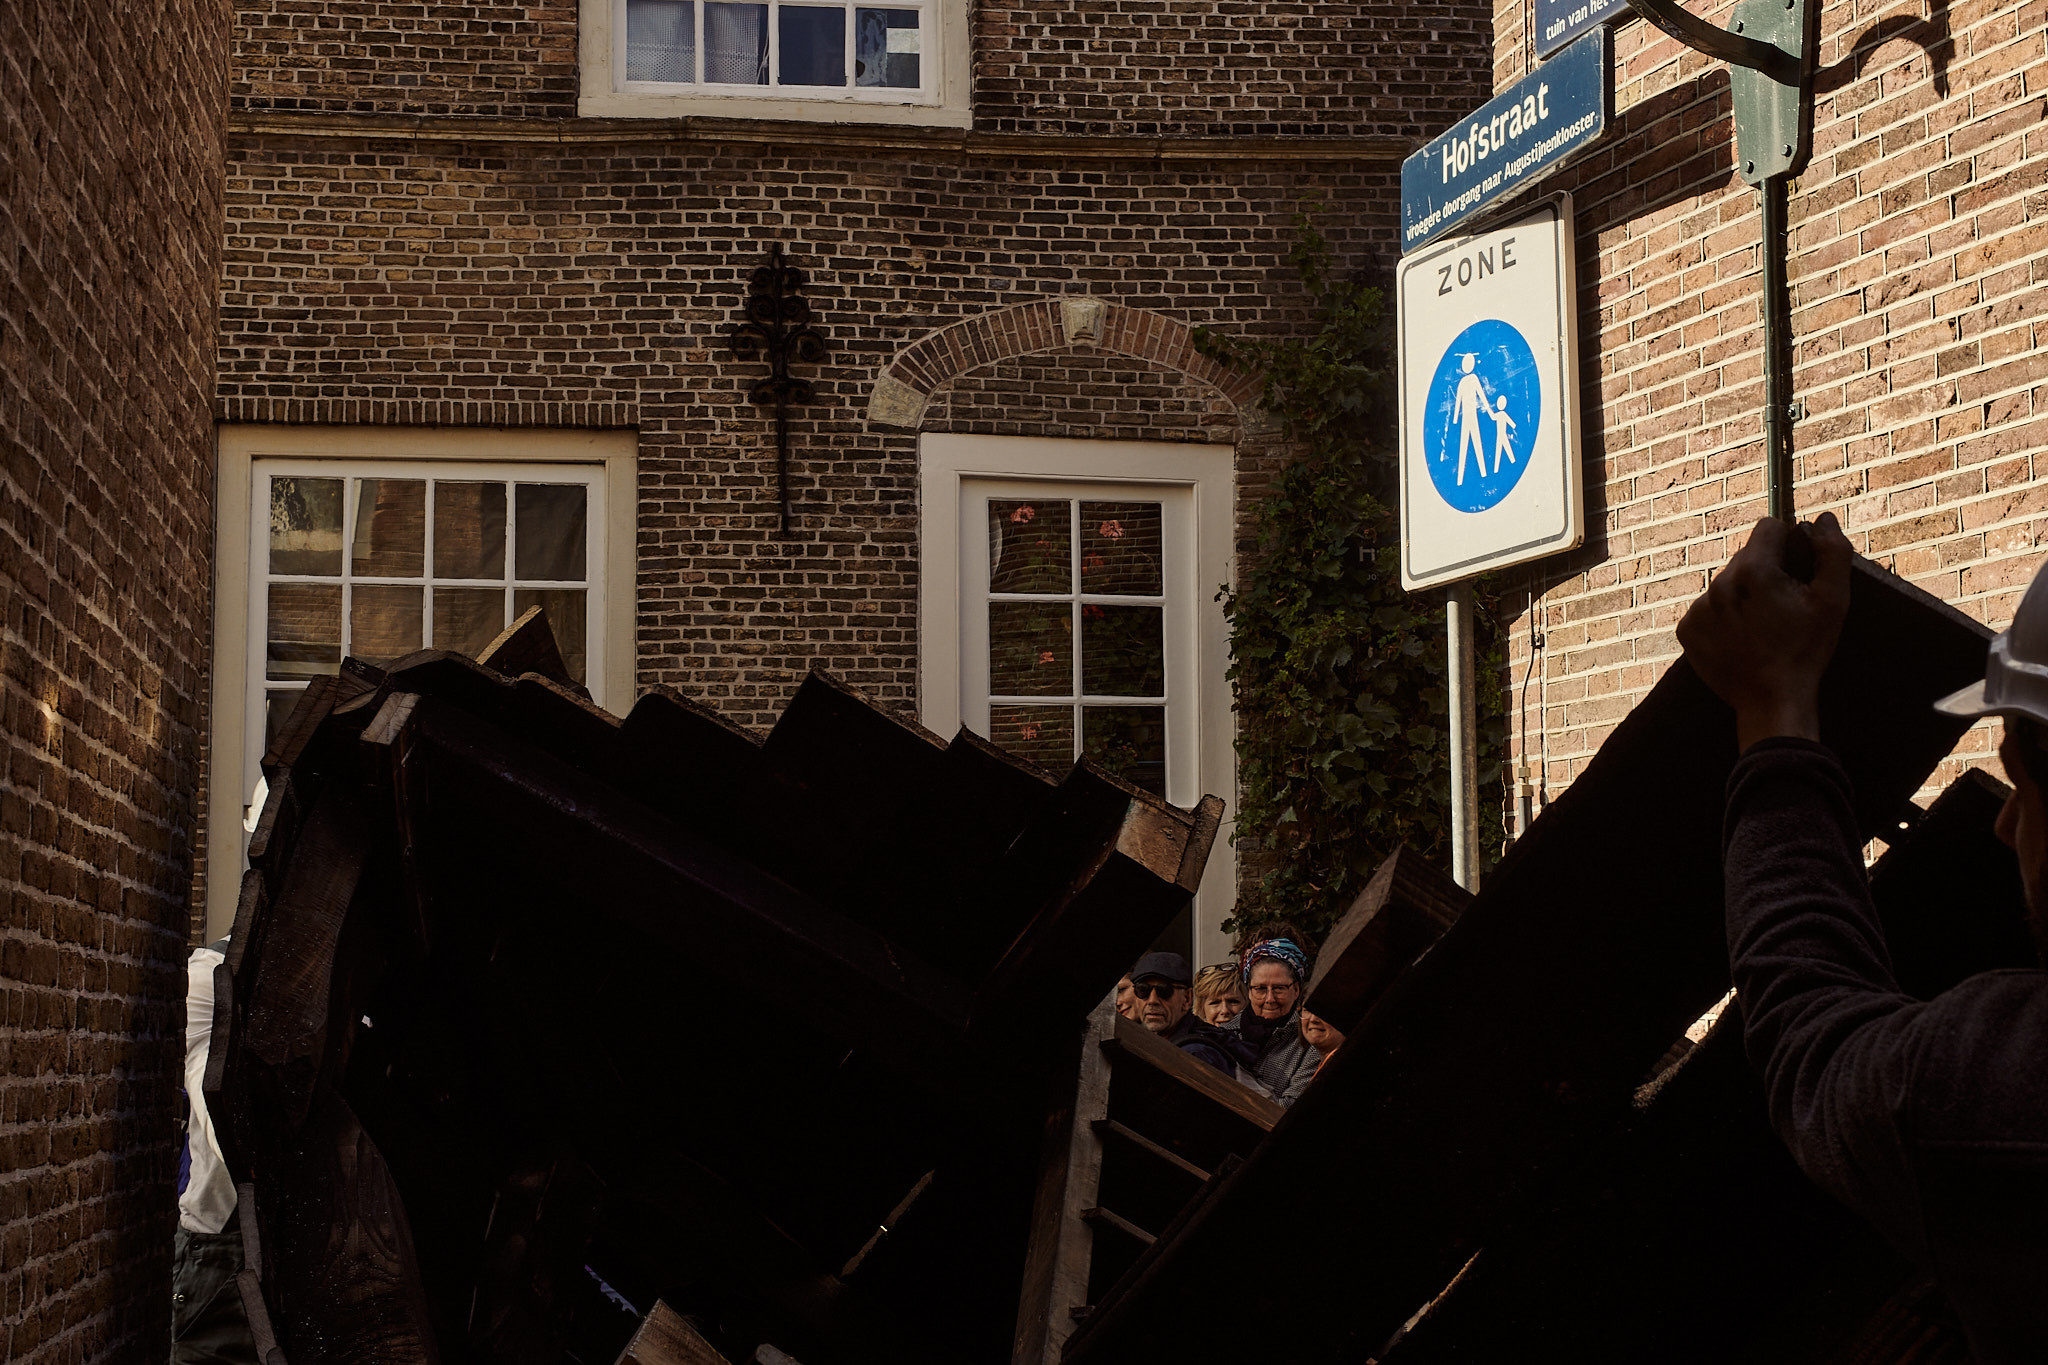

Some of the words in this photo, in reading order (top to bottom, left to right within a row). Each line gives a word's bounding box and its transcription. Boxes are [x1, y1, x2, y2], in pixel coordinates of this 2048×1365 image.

[1546, 18, 1566, 41] tuin
[1568, 5, 1588, 27] van
[1442, 81, 1549, 184] Hofstraat
[1406, 209, 1442, 242] vroegere
[1442, 184, 1481, 219] doorgang
[1482, 170, 1502, 194] naar
[1504, 111, 1596, 180] Augustijnenklooster
[1438, 236, 1517, 297] ZONE
